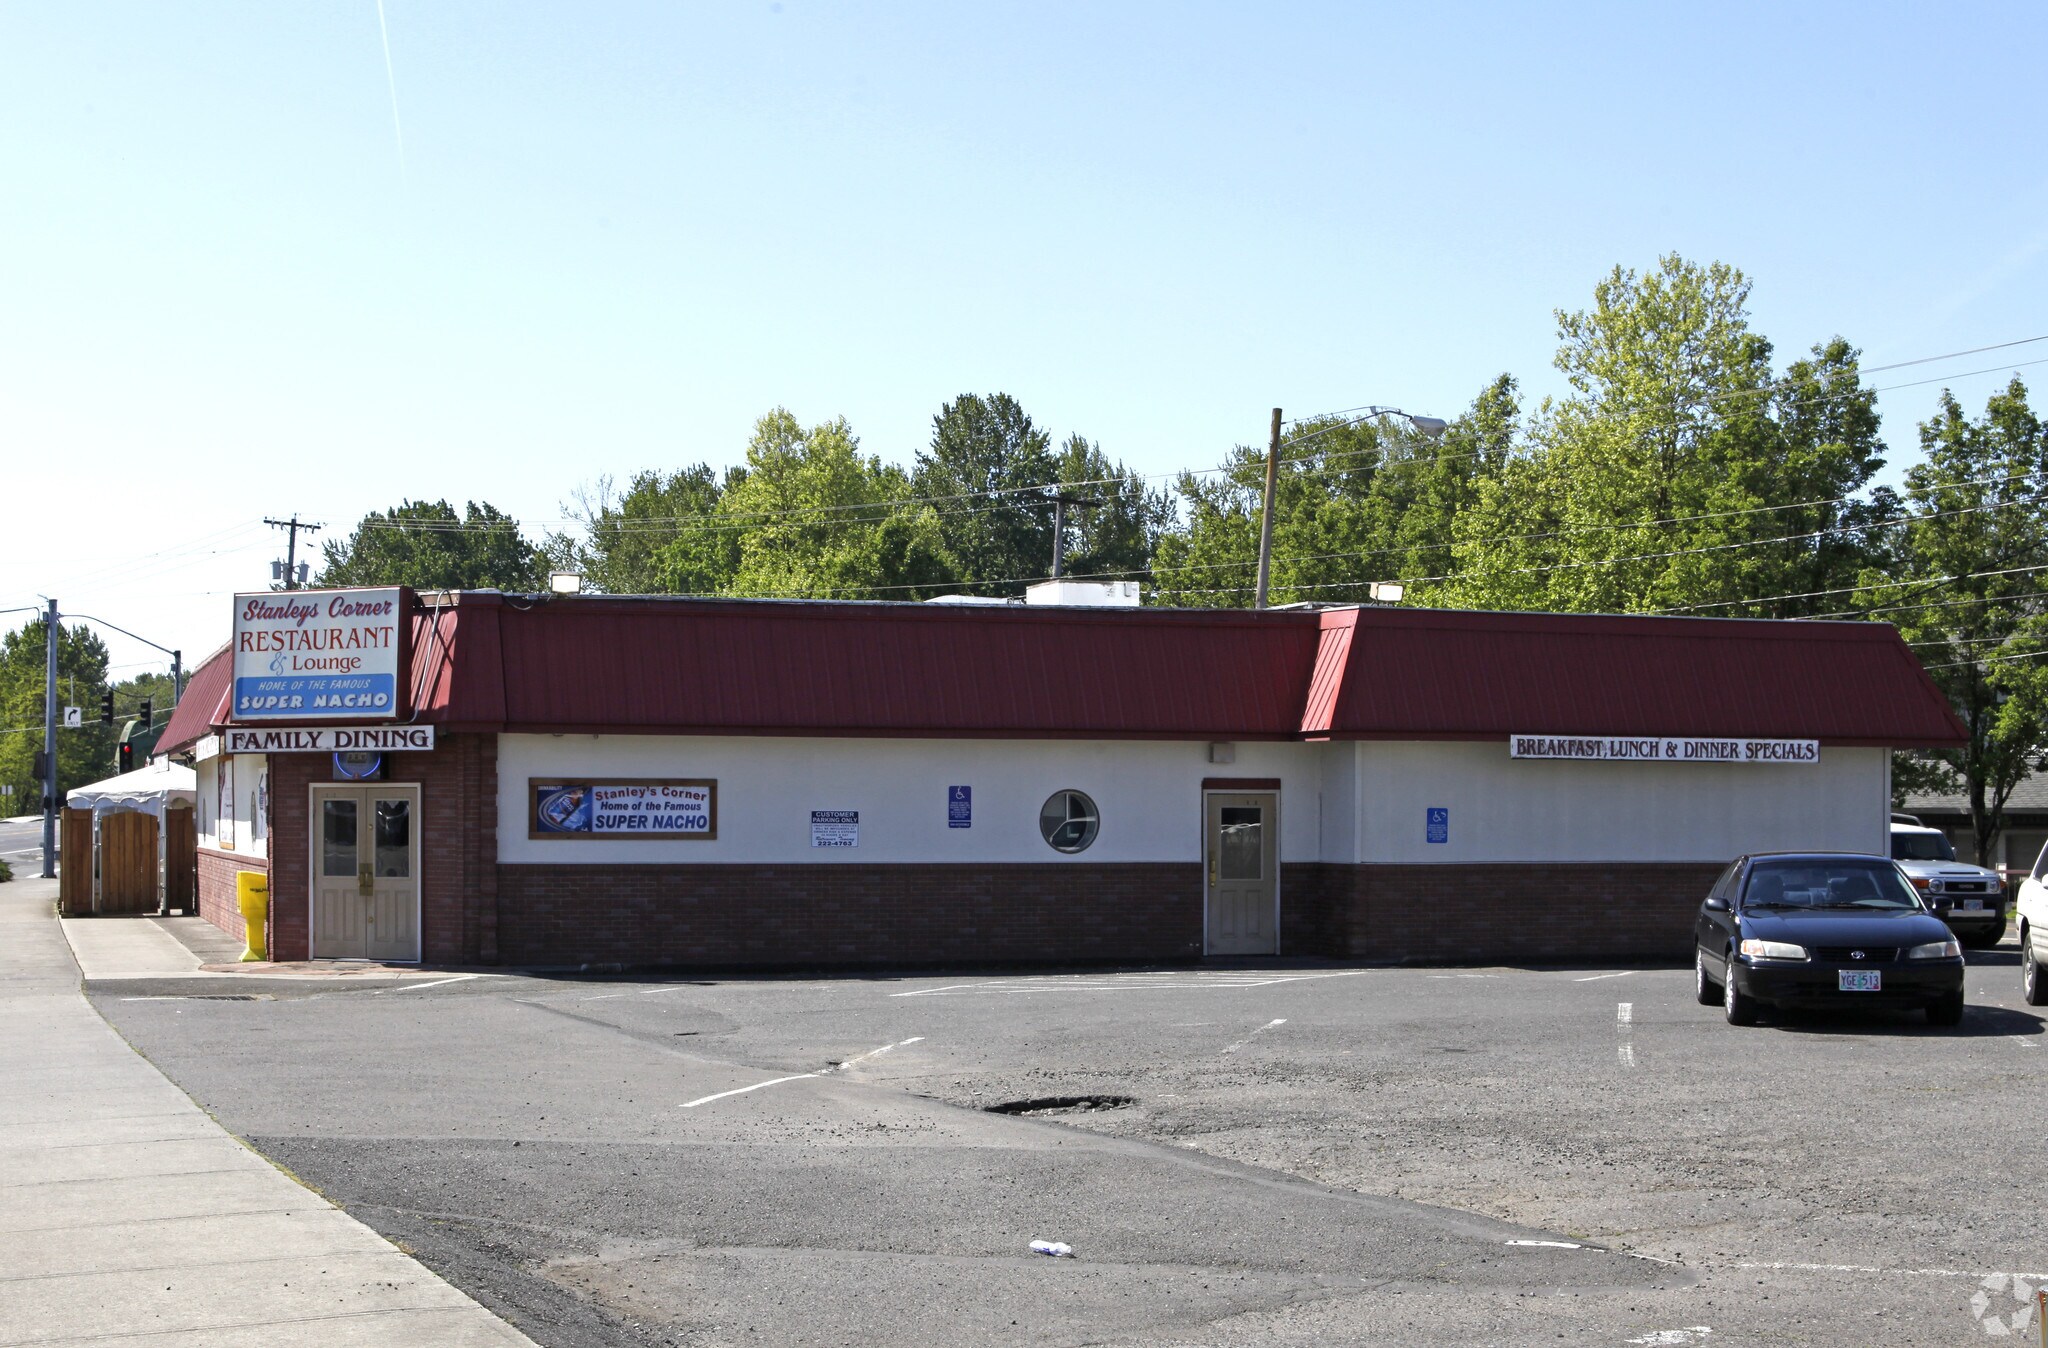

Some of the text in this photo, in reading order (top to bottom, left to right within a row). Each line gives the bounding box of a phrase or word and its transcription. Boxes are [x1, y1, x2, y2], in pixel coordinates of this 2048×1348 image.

[243, 596, 393, 627] Stanleys Corner
[239, 626, 394, 653] RESTAURANT
[269, 651, 362, 676] & Lounge
[258, 679, 371, 691] HOME OF THE FAMOUS
[240, 692, 388, 710] SUPER NACHO
[231, 731, 324, 750] FAMILY
[334, 729, 428, 749] DINING
[1609, 741, 1659, 758] LUNCH
[1665, 741, 1679, 758] &
[1683, 742, 1740, 759] DINNER
[1745, 743, 1814, 761] SPECIALS
[595, 786, 707, 802] Stanley's Corner
[600, 801, 701, 811] Home of the Famous
[595, 815, 708, 829] SUPER NACHO
[1840, 975, 1879, 986] YGE 513
